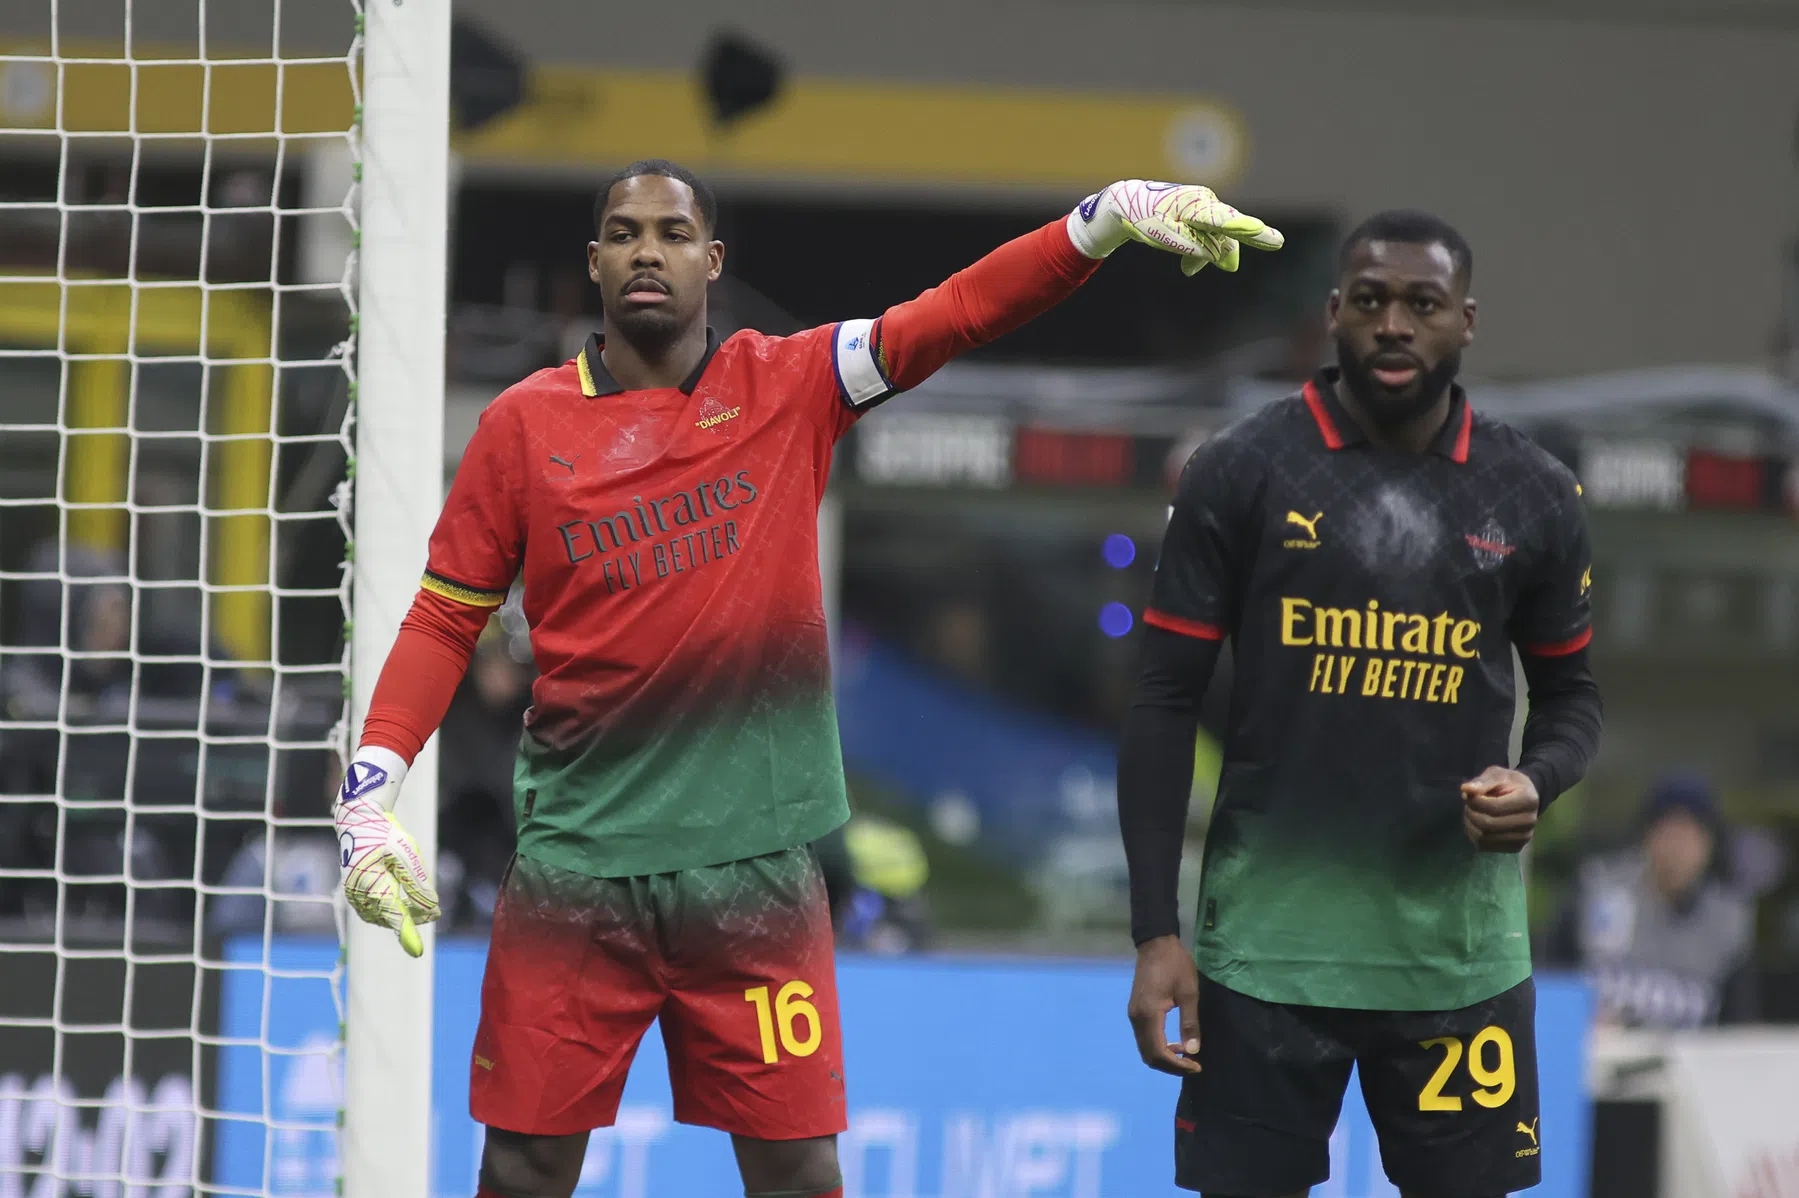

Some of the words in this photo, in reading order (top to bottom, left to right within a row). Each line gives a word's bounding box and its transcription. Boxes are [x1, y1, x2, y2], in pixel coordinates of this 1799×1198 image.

[1147, 226, 1196, 256] uhlsport
[557, 470, 758, 564] Emirates
[603, 551, 642, 594] FLY
[653, 520, 741, 579] BETTER
[1281, 597, 1481, 660] Emirate
[1310, 654, 1356, 694] FLY
[1362, 658, 1464, 704] BETTER
[397, 838, 427, 882] uhlsport
[744, 980, 822, 1064] 16
[1418, 1025, 1516, 1112] 29
